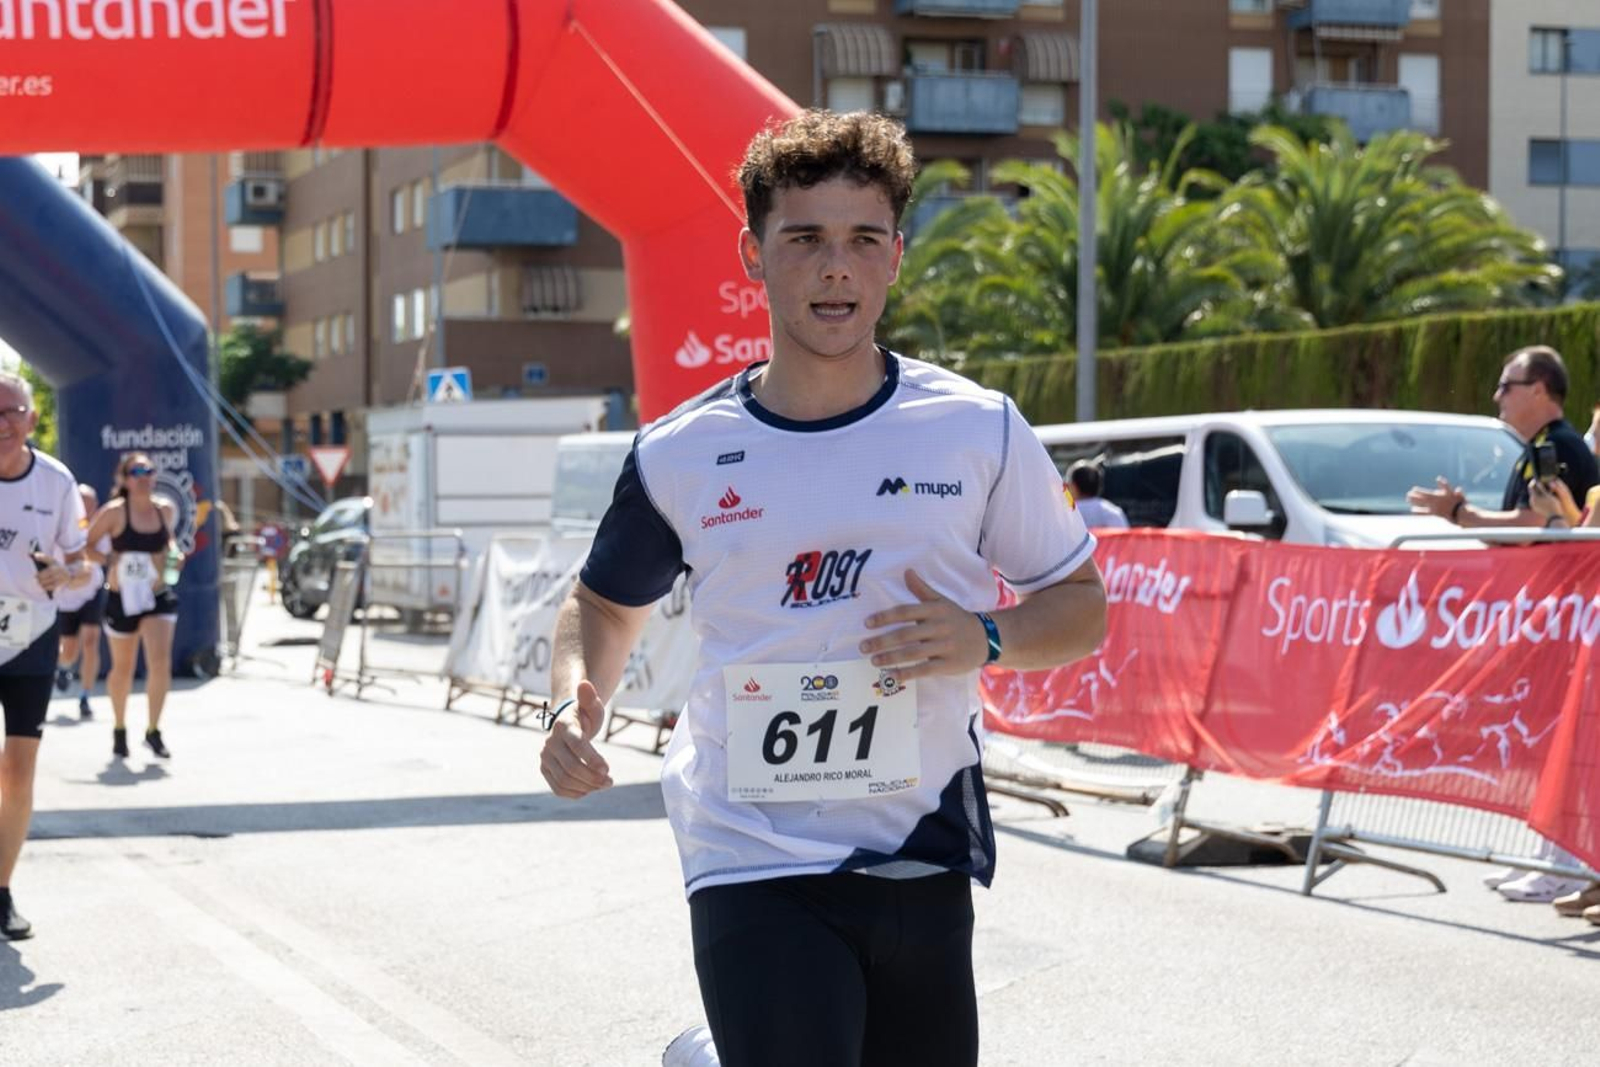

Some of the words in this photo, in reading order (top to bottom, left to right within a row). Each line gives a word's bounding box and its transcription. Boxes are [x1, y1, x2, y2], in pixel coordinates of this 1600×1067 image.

[101, 424, 204, 449] fundación
[914, 480, 962, 498] mupol
[701, 507, 764, 529] Santander
[1261, 577, 1371, 655] Sports
[732, 693, 772, 701] Santander
[762, 705, 879, 765] 611
[774, 772, 822, 783] ALEJANDRO
[823, 771, 843, 781] RICO
[845, 769, 873, 779] MORAL
